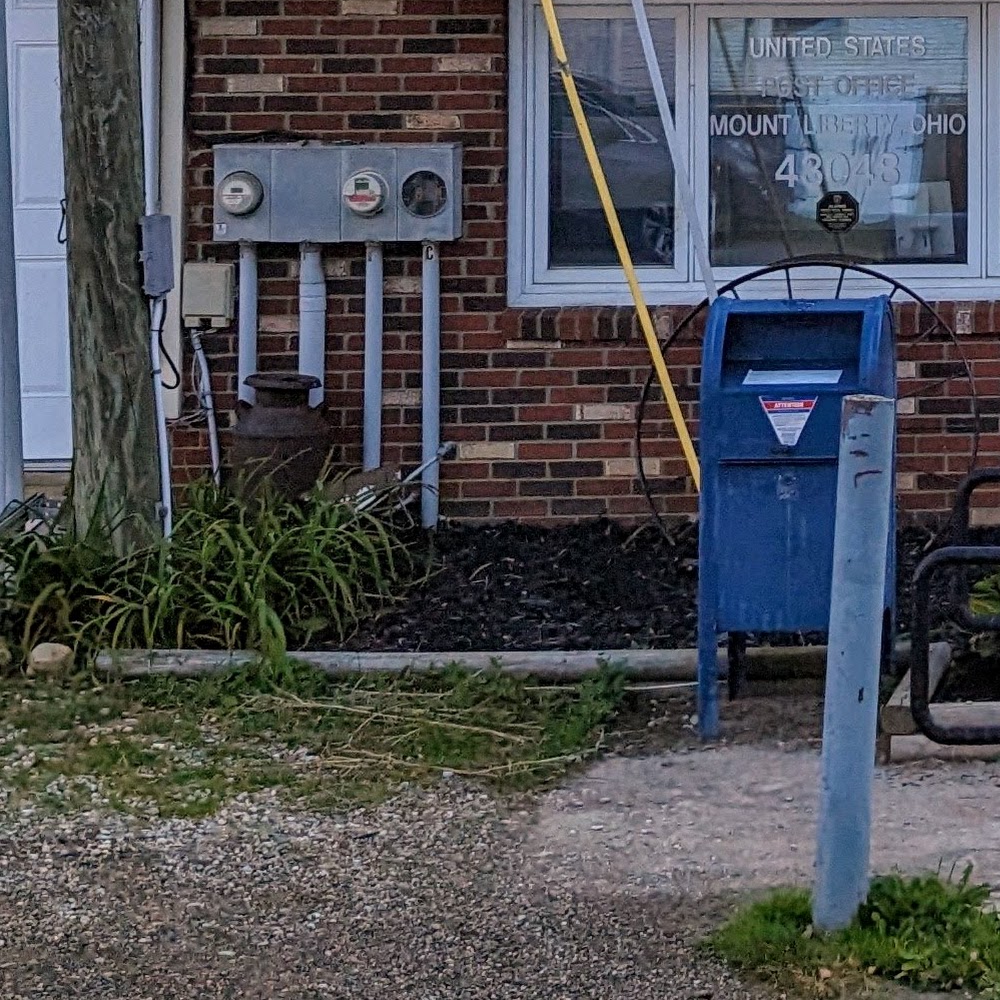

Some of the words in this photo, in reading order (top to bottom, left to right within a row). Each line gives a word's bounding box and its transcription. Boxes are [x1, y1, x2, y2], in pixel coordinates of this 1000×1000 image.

[750, 36, 832, 58] UNITED
[845, 36, 926, 58] STATES
[761, 75, 823, 98] POST
[835, 74, 915, 97] OFFICE
[710, 114, 792, 136] MOUNT
[912, 113, 966, 135] OHIO
